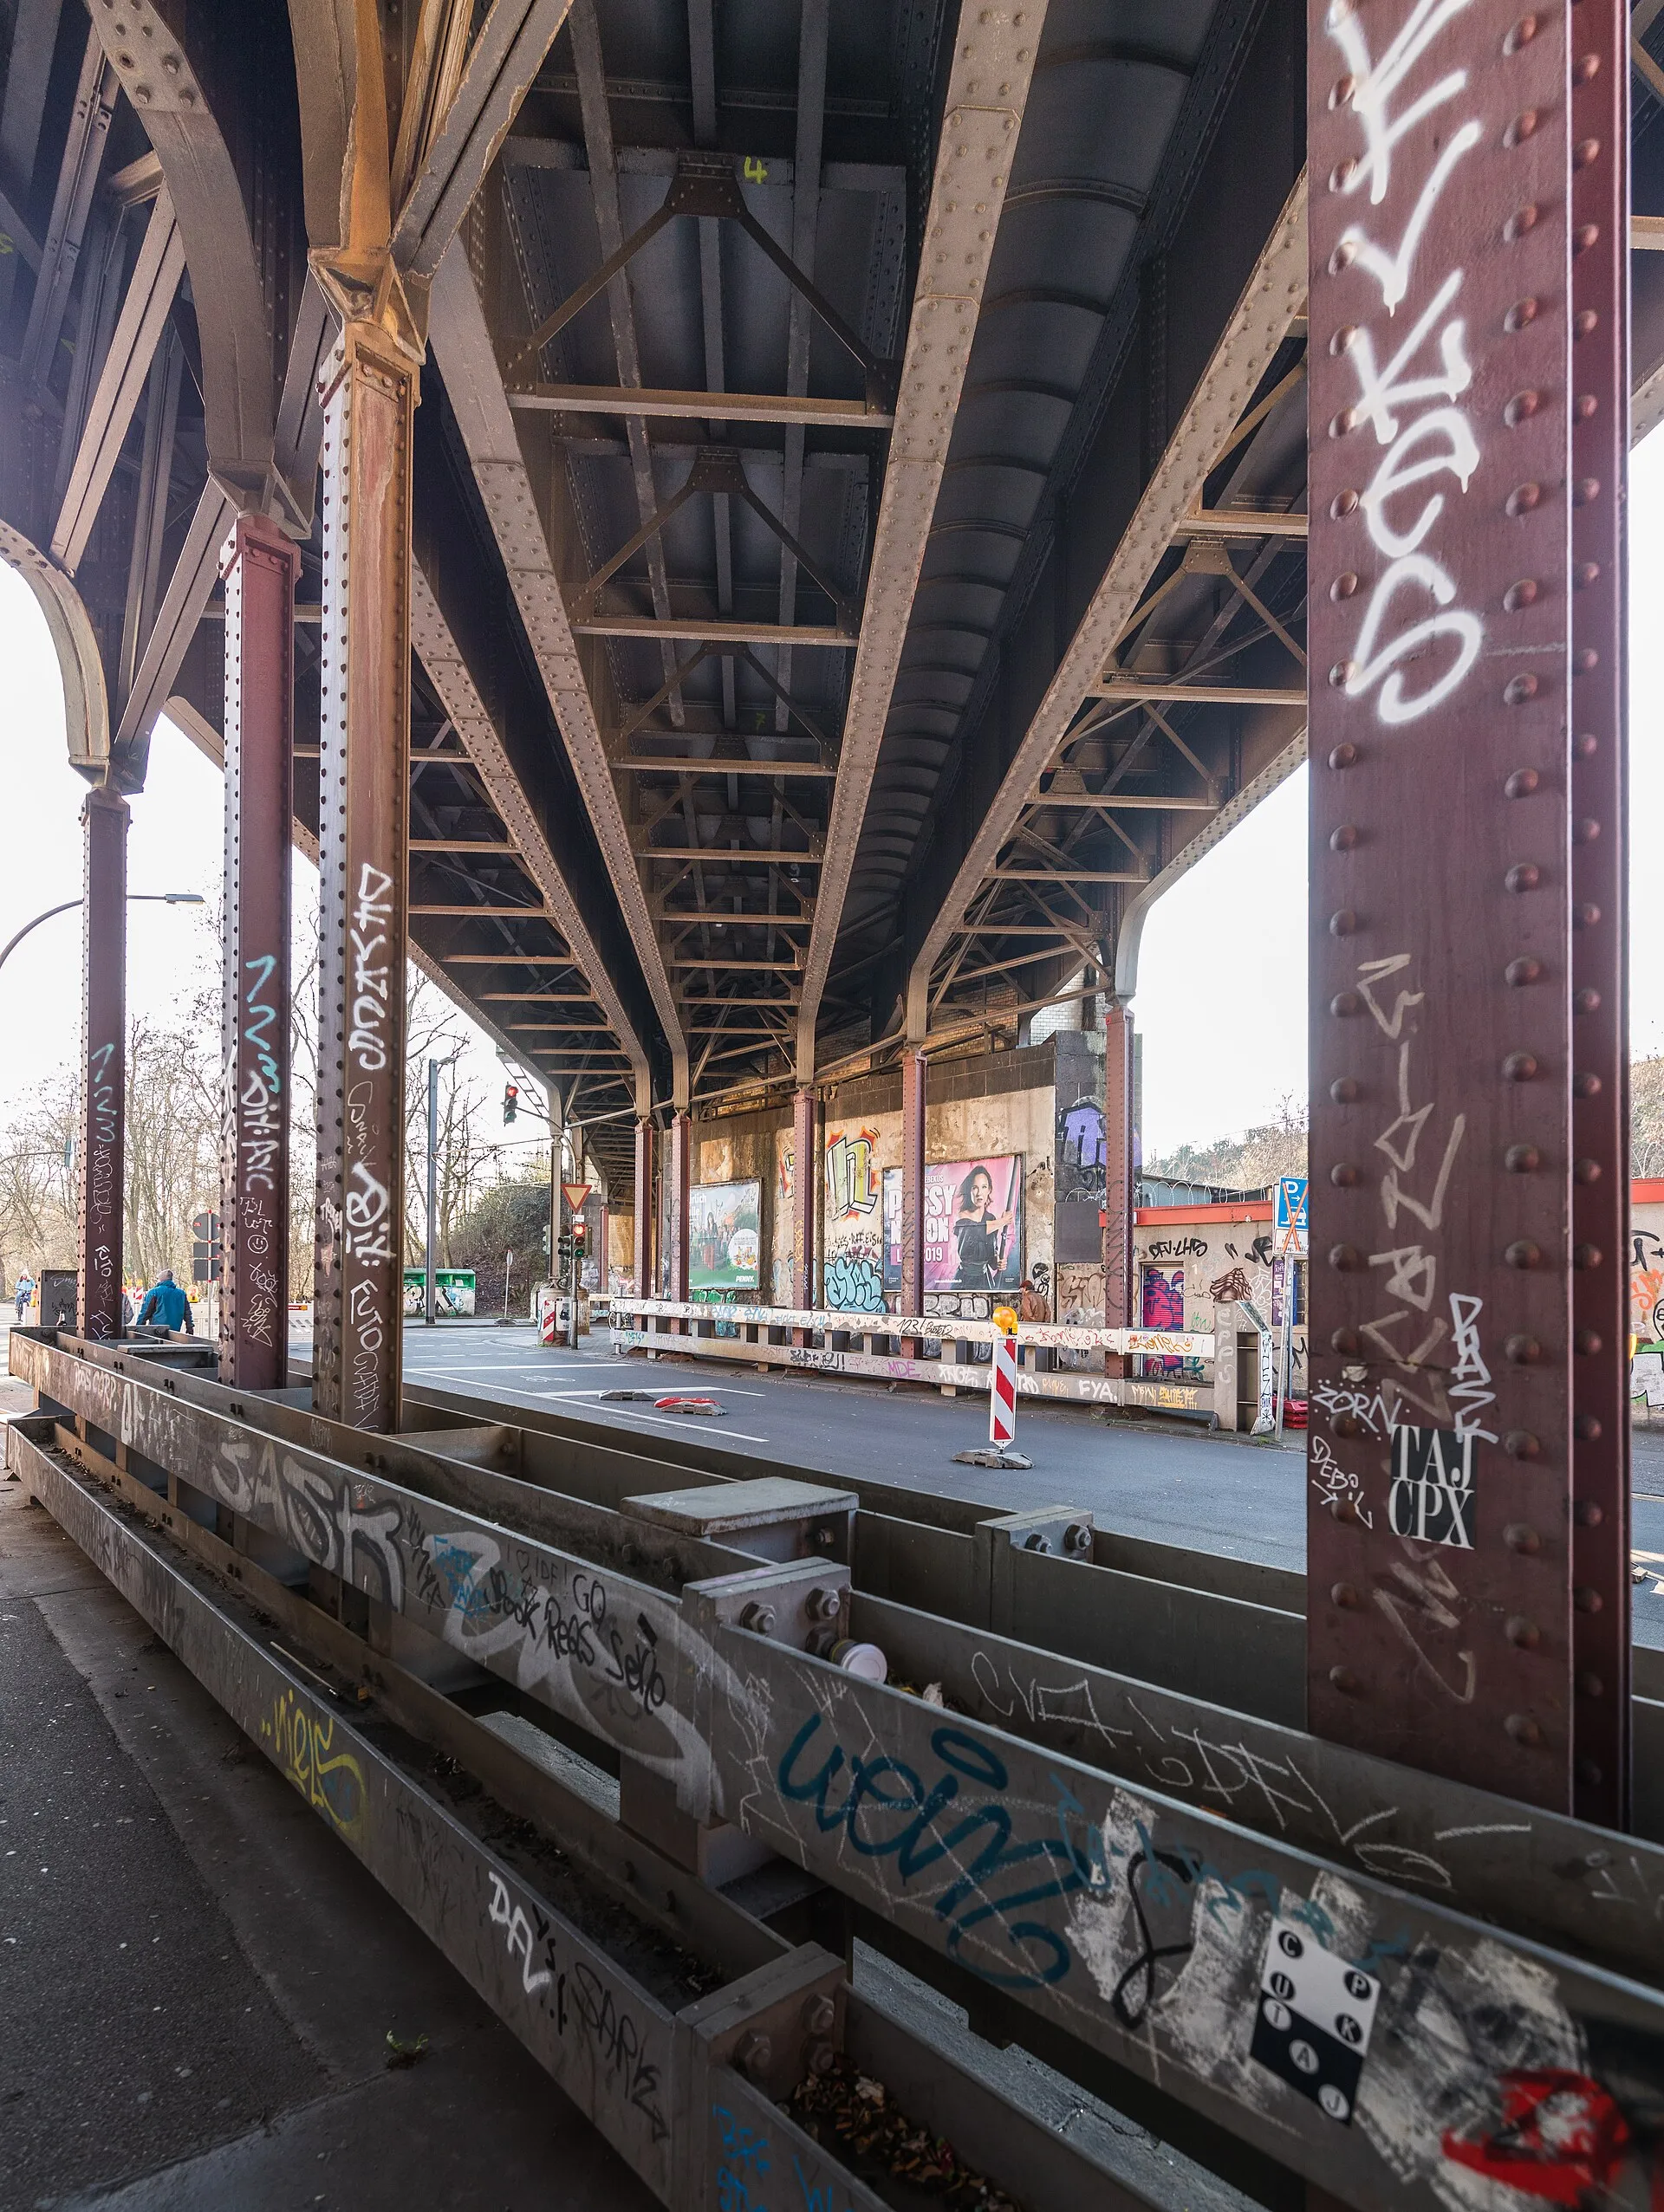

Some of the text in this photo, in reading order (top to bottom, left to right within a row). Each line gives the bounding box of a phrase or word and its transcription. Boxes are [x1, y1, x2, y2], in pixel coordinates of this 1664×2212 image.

[744, 156, 768, 185] 4
[925, 1174, 944, 1184] EBEKUS
[1285, 1181, 1299, 1194] P
[888, 1184, 957, 1220] PSY
[924, 1247, 943, 1263] 019
[887, 1360, 922, 1378] MDE
[1390, 1424, 1474, 1492] TAJ
[1388, 1479, 1476, 1551] CPX
